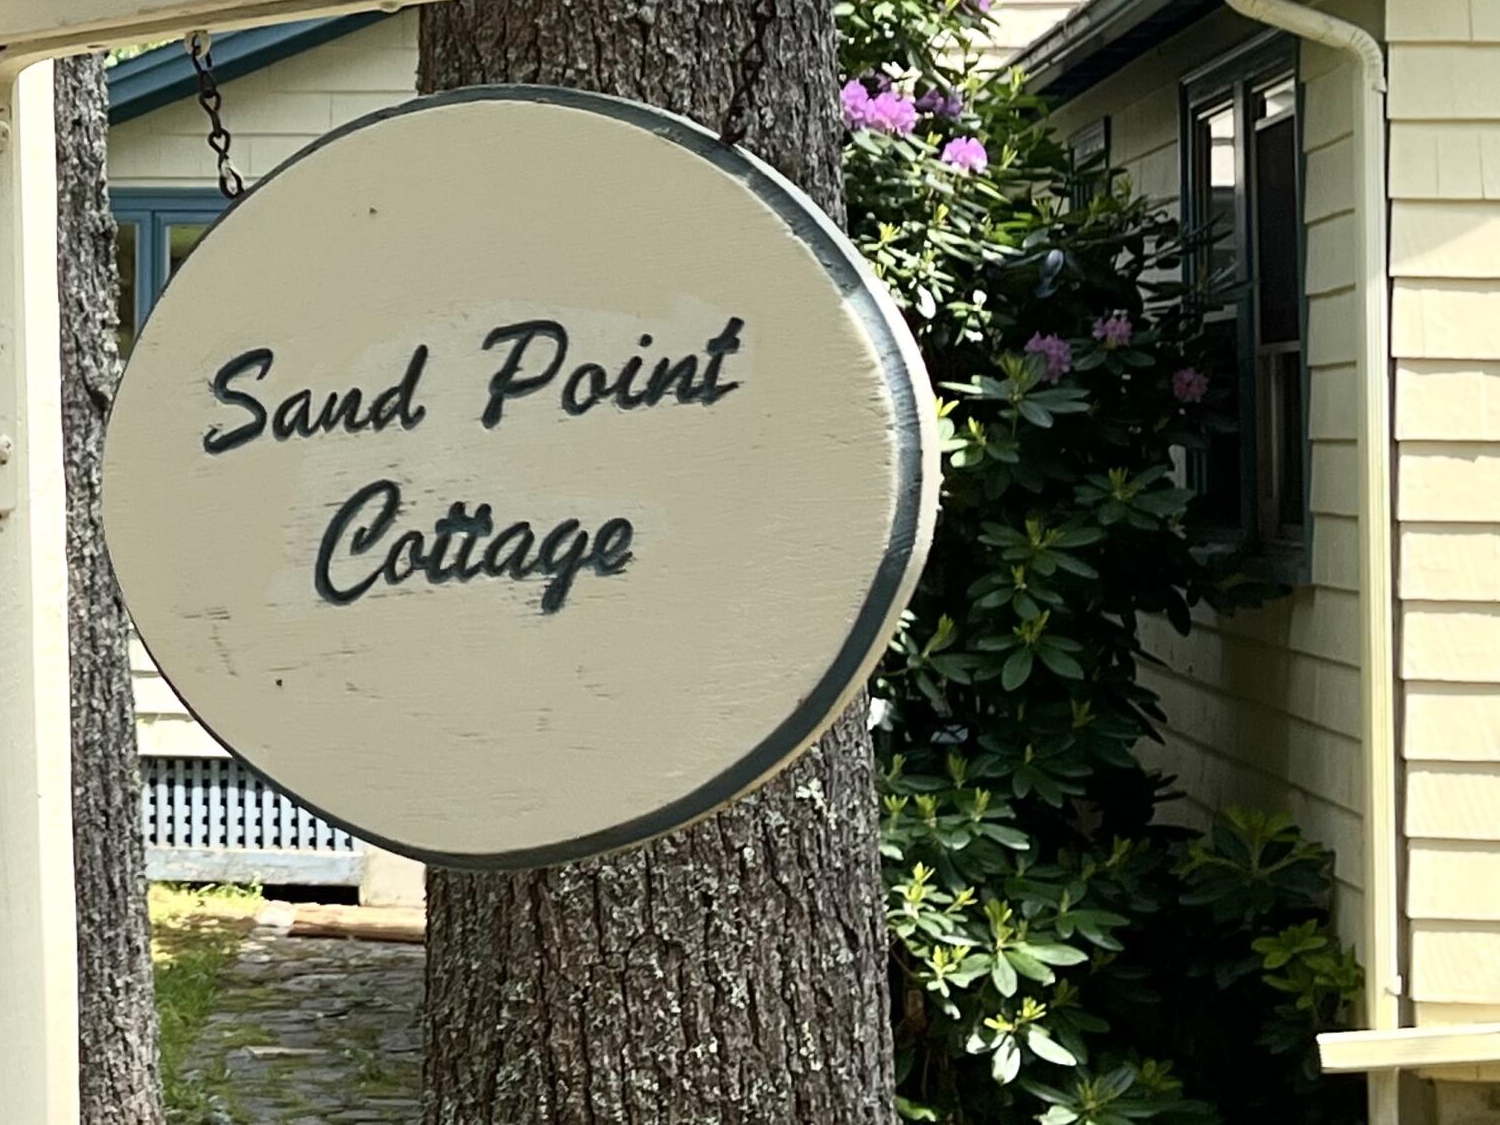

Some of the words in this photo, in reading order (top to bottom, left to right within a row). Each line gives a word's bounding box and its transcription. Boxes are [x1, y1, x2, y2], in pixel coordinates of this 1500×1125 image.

[203, 344, 429, 455] Sand
[481, 316, 745, 430] Point
[314, 479, 634, 616] Cottage
